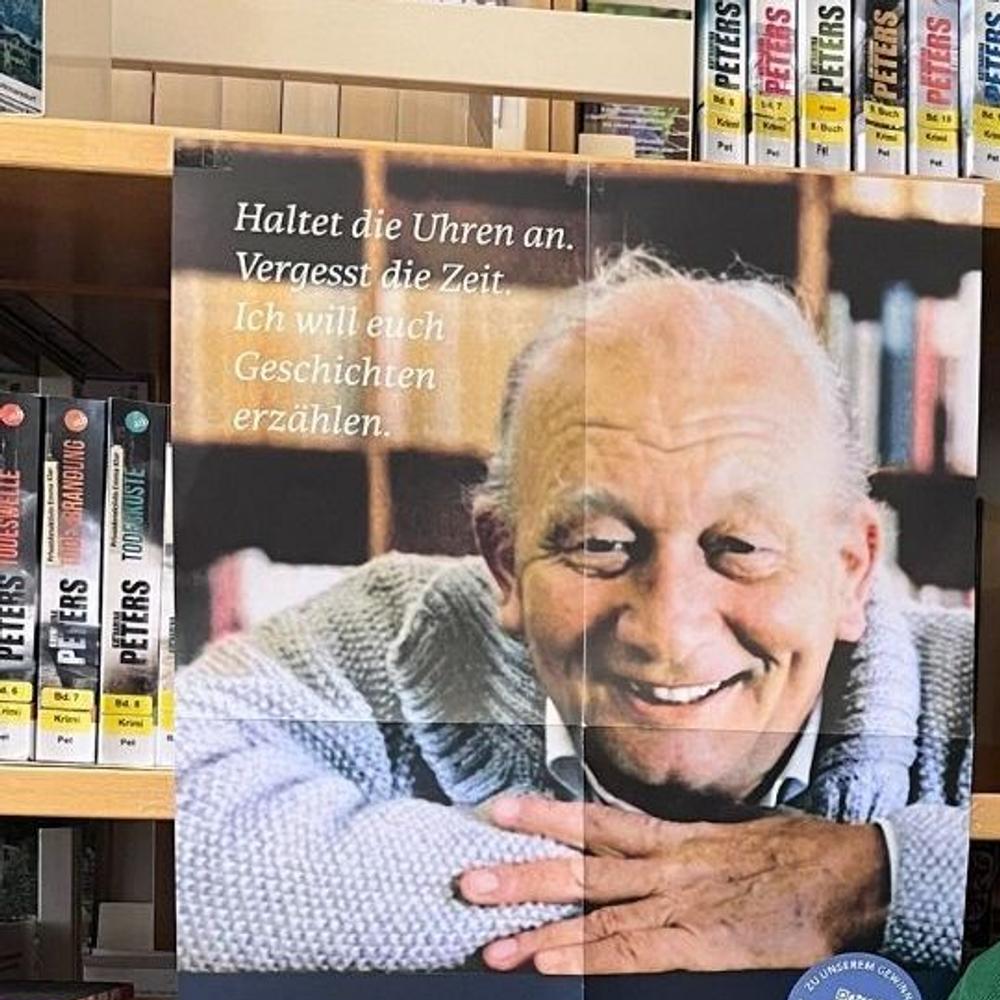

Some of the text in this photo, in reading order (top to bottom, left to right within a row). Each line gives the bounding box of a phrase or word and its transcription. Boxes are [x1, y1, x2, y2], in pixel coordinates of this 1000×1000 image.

[715, 1, 741, 90] PETERS
[765, 7, 791, 95] PETERS
[819, 5, 845, 92] PETERS
[874, 8, 900, 100] PETERS
[927, 16, 951, 105] PETERS
[234, 202, 575, 250] Haltet die Uhren an.
[235, 252, 511, 295] Vergesst die Zeit.
[234, 301, 446, 341] Ich will euch
[234, 351, 437, 390] Geschichten
[233, 403, 391, 437] erzählen.
[0, 574, 26, 661] PETERS
[58, 578, 88, 665] PETERS
[120, 580, 150, 664] PETERS
[804, 976, 820, 992] ZU
[820, 960, 876, 980] UNSEREM
